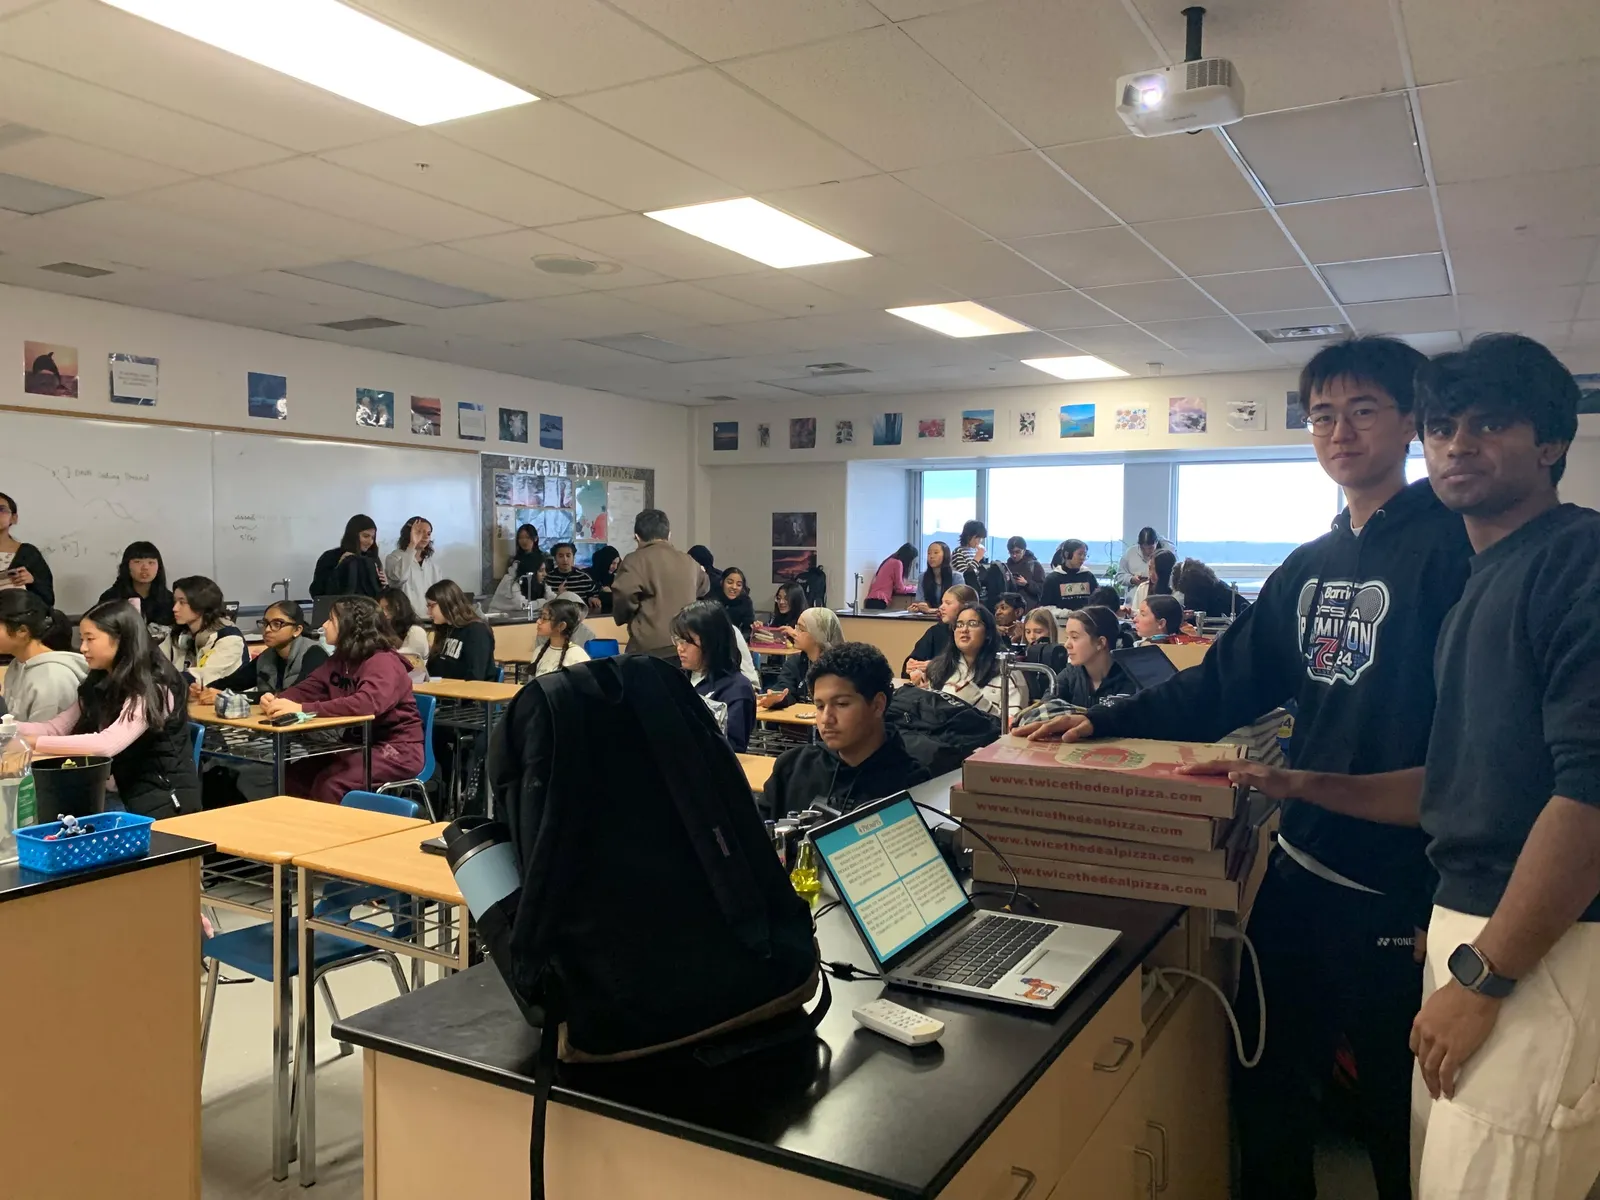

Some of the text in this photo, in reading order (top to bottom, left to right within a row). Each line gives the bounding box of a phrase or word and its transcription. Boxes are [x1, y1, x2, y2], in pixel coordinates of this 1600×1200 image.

[508, 456, 636, 480] WELCOME TO BIOLOGY
[989, 773, 1203, 803] www.twicethedealpizza.com
[976, 800, 1183, 836] www.twicethedealpizza.com
[986, 831, 1195, 865] www.twicethedealpizza.com
[1391, 937, 1416, 946] YONE
